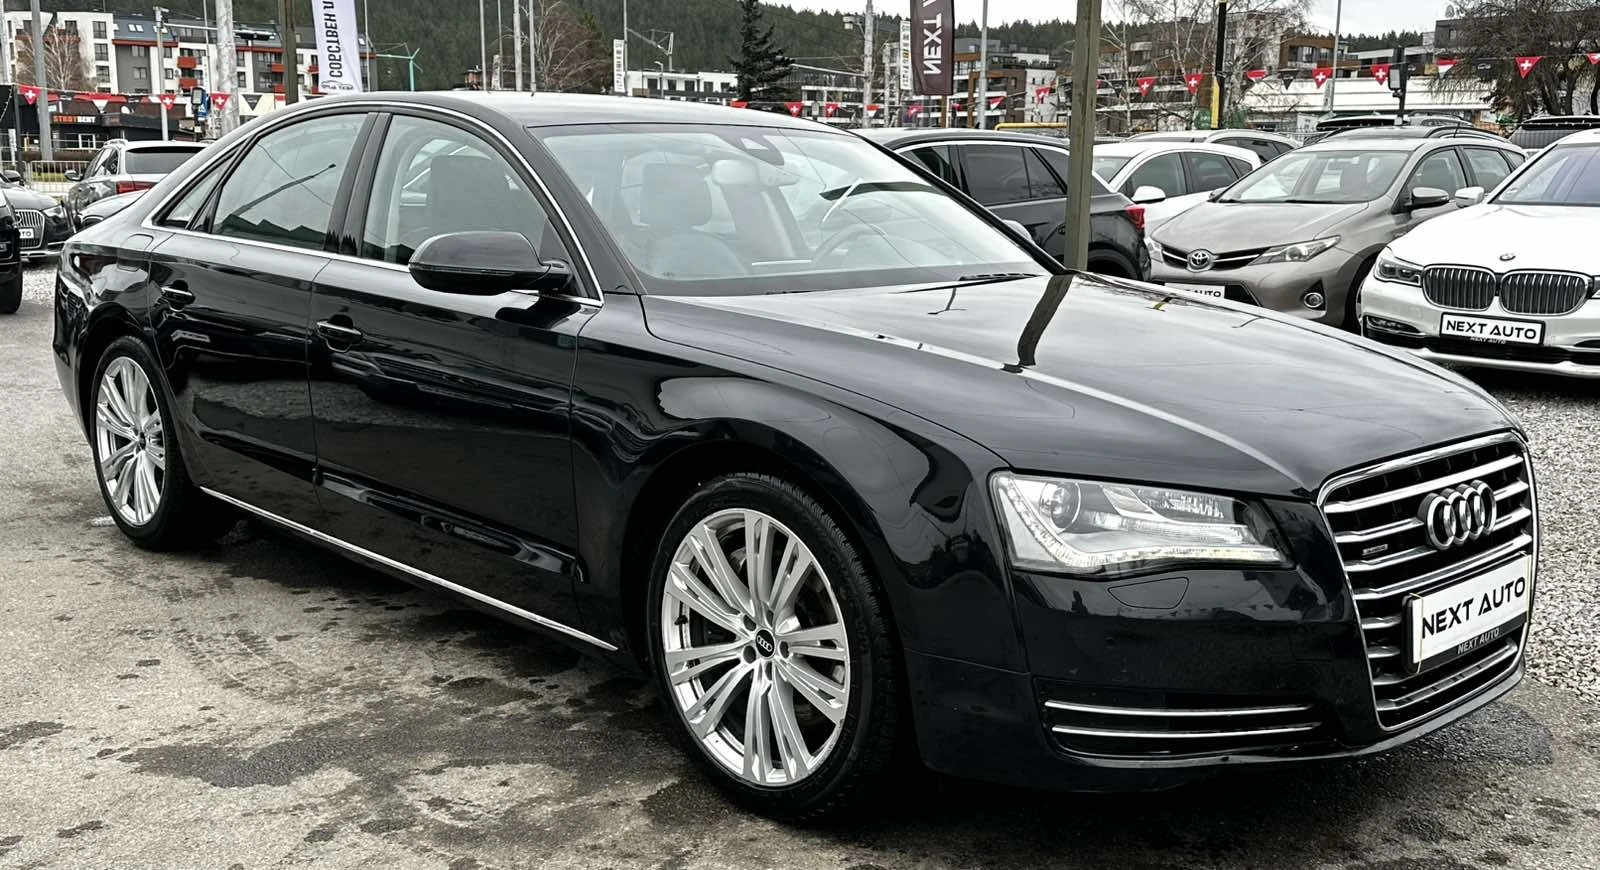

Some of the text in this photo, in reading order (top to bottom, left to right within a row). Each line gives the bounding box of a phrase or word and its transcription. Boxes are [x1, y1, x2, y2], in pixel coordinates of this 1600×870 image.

[1446, 319, 1537, 340] NEXT AUTO
[1421, 576, 1526, 639] NEXT AUTO
[1457, 627, 1500, 655] NEXT AUTO
